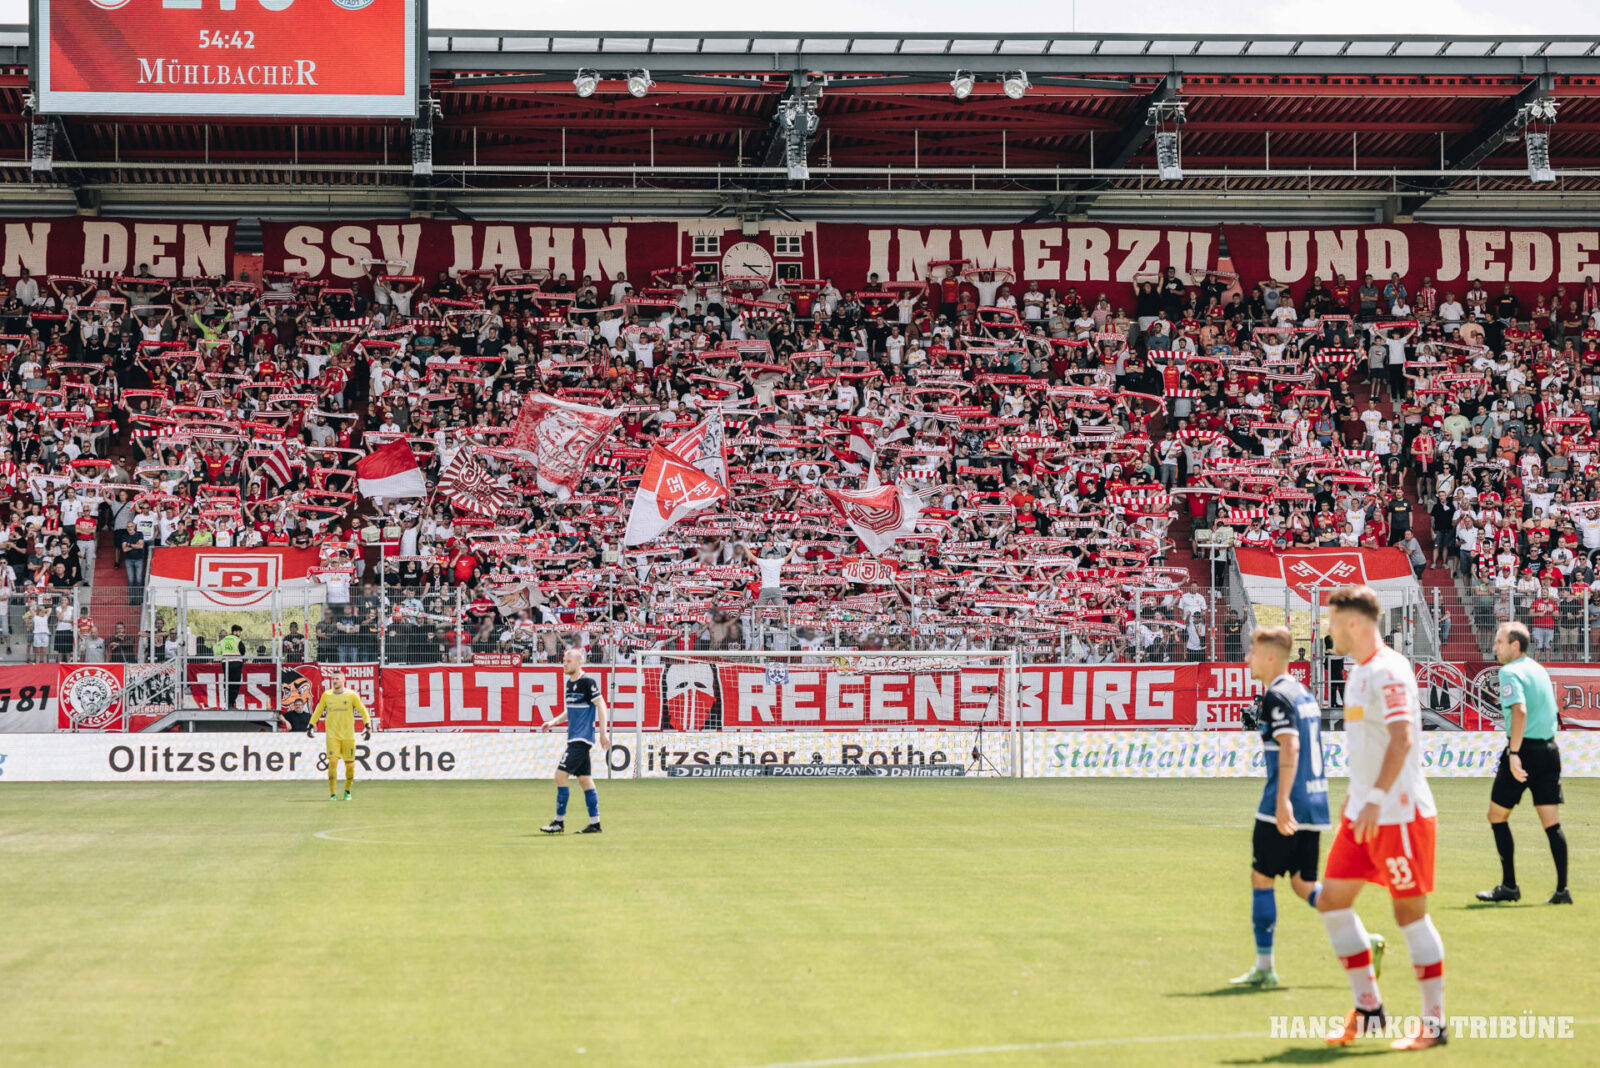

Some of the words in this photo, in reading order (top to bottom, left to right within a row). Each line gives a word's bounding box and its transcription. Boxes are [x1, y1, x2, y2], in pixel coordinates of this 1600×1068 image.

[199, 30, 255, 49] 54:42
[137, 58, 318, 86] MÜHLBACHER
[82, 221, 229, 278] DEN
[283, 224, 421, 279] SSV
[449, 225, 628, 281] JAHN
[1266, 229, 1410, 283] UND
[346, 666, 374, 678] JAHN
[1208, 667, 1266, 697] JAH
[16, 685, 51, 712] 81
[405, 671, 646, 723] ULTRS
[738, 670, 1176, 723] REGENSBURG
[108, 744, 302, 772] Olitzscher
[354, 744, 456, 772] Rothe
[606, 744, 796, 772] Oitzscher
[841, 744, 948, 767] Rothe
[691, 766, 761, 777] Dallmeier
[891, 766, 960, 777] Dallmeier
[1050, 743, 1238, 769] Stahlhallen
[1322, 743, 1501, 773] Rsburg
[1386, 856, 1413, 885] 33
